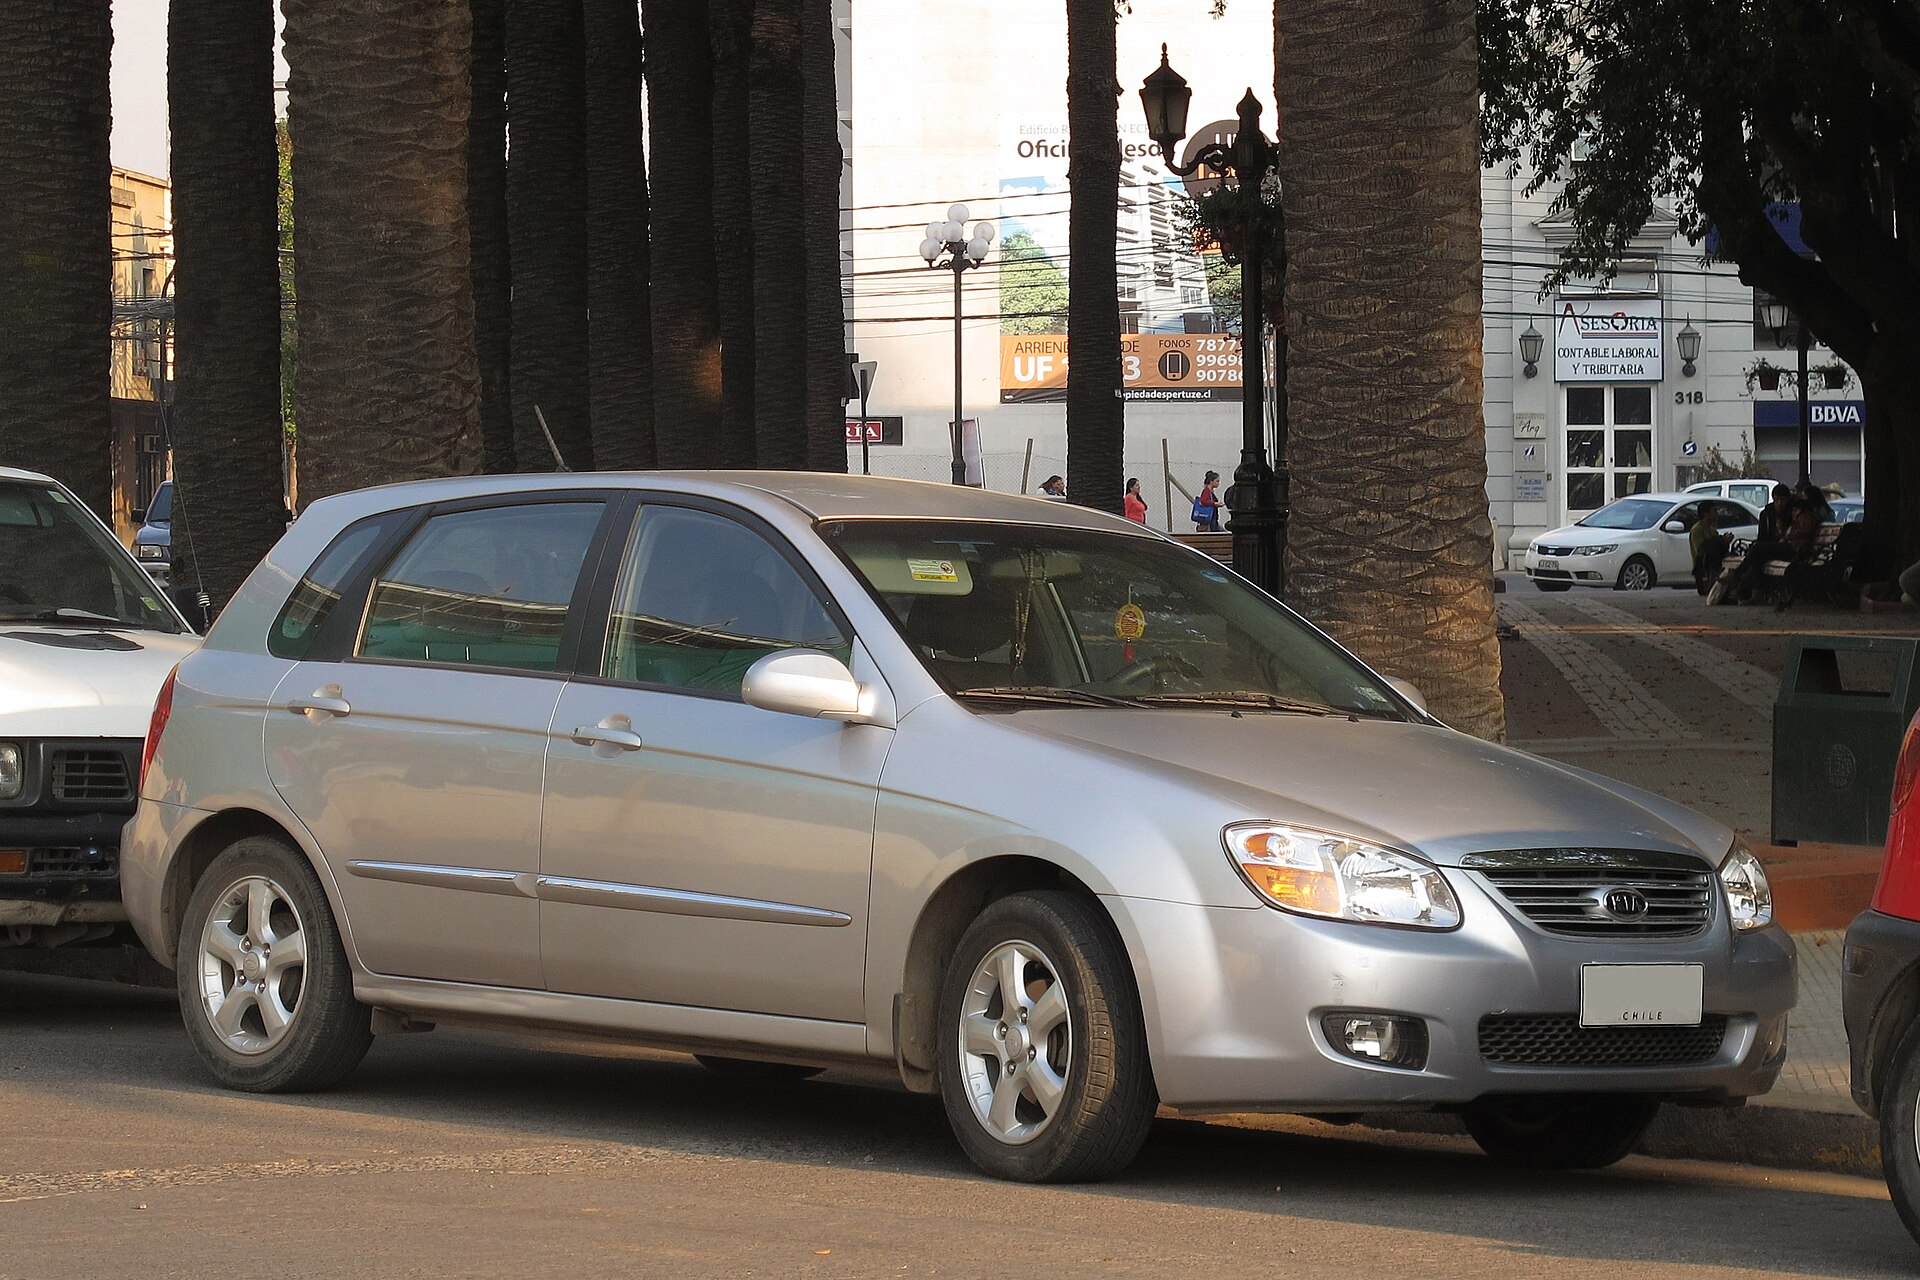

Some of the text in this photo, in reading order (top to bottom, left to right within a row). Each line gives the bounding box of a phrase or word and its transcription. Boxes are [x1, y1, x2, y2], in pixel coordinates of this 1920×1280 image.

[1019, 124, 1059, 135] Edificio
[1017, 139, 1067, 158] Ofici
[1158, 339, 1191, 348] FONOS
[1557, 347, 1659, 359] CONTABLE LABORAL
[1013, 356, 1054, 382] UF
[1572, 362, 1645, 375] Y TRIBUTARIA
[1122, 389, 1211, 401] piedadespertuze.cl
[1675, 392, 1704, 405] 318
[1811, 405, 1861, 423] BBVA
[1622, 1011, 1663, 1021] CHILE
